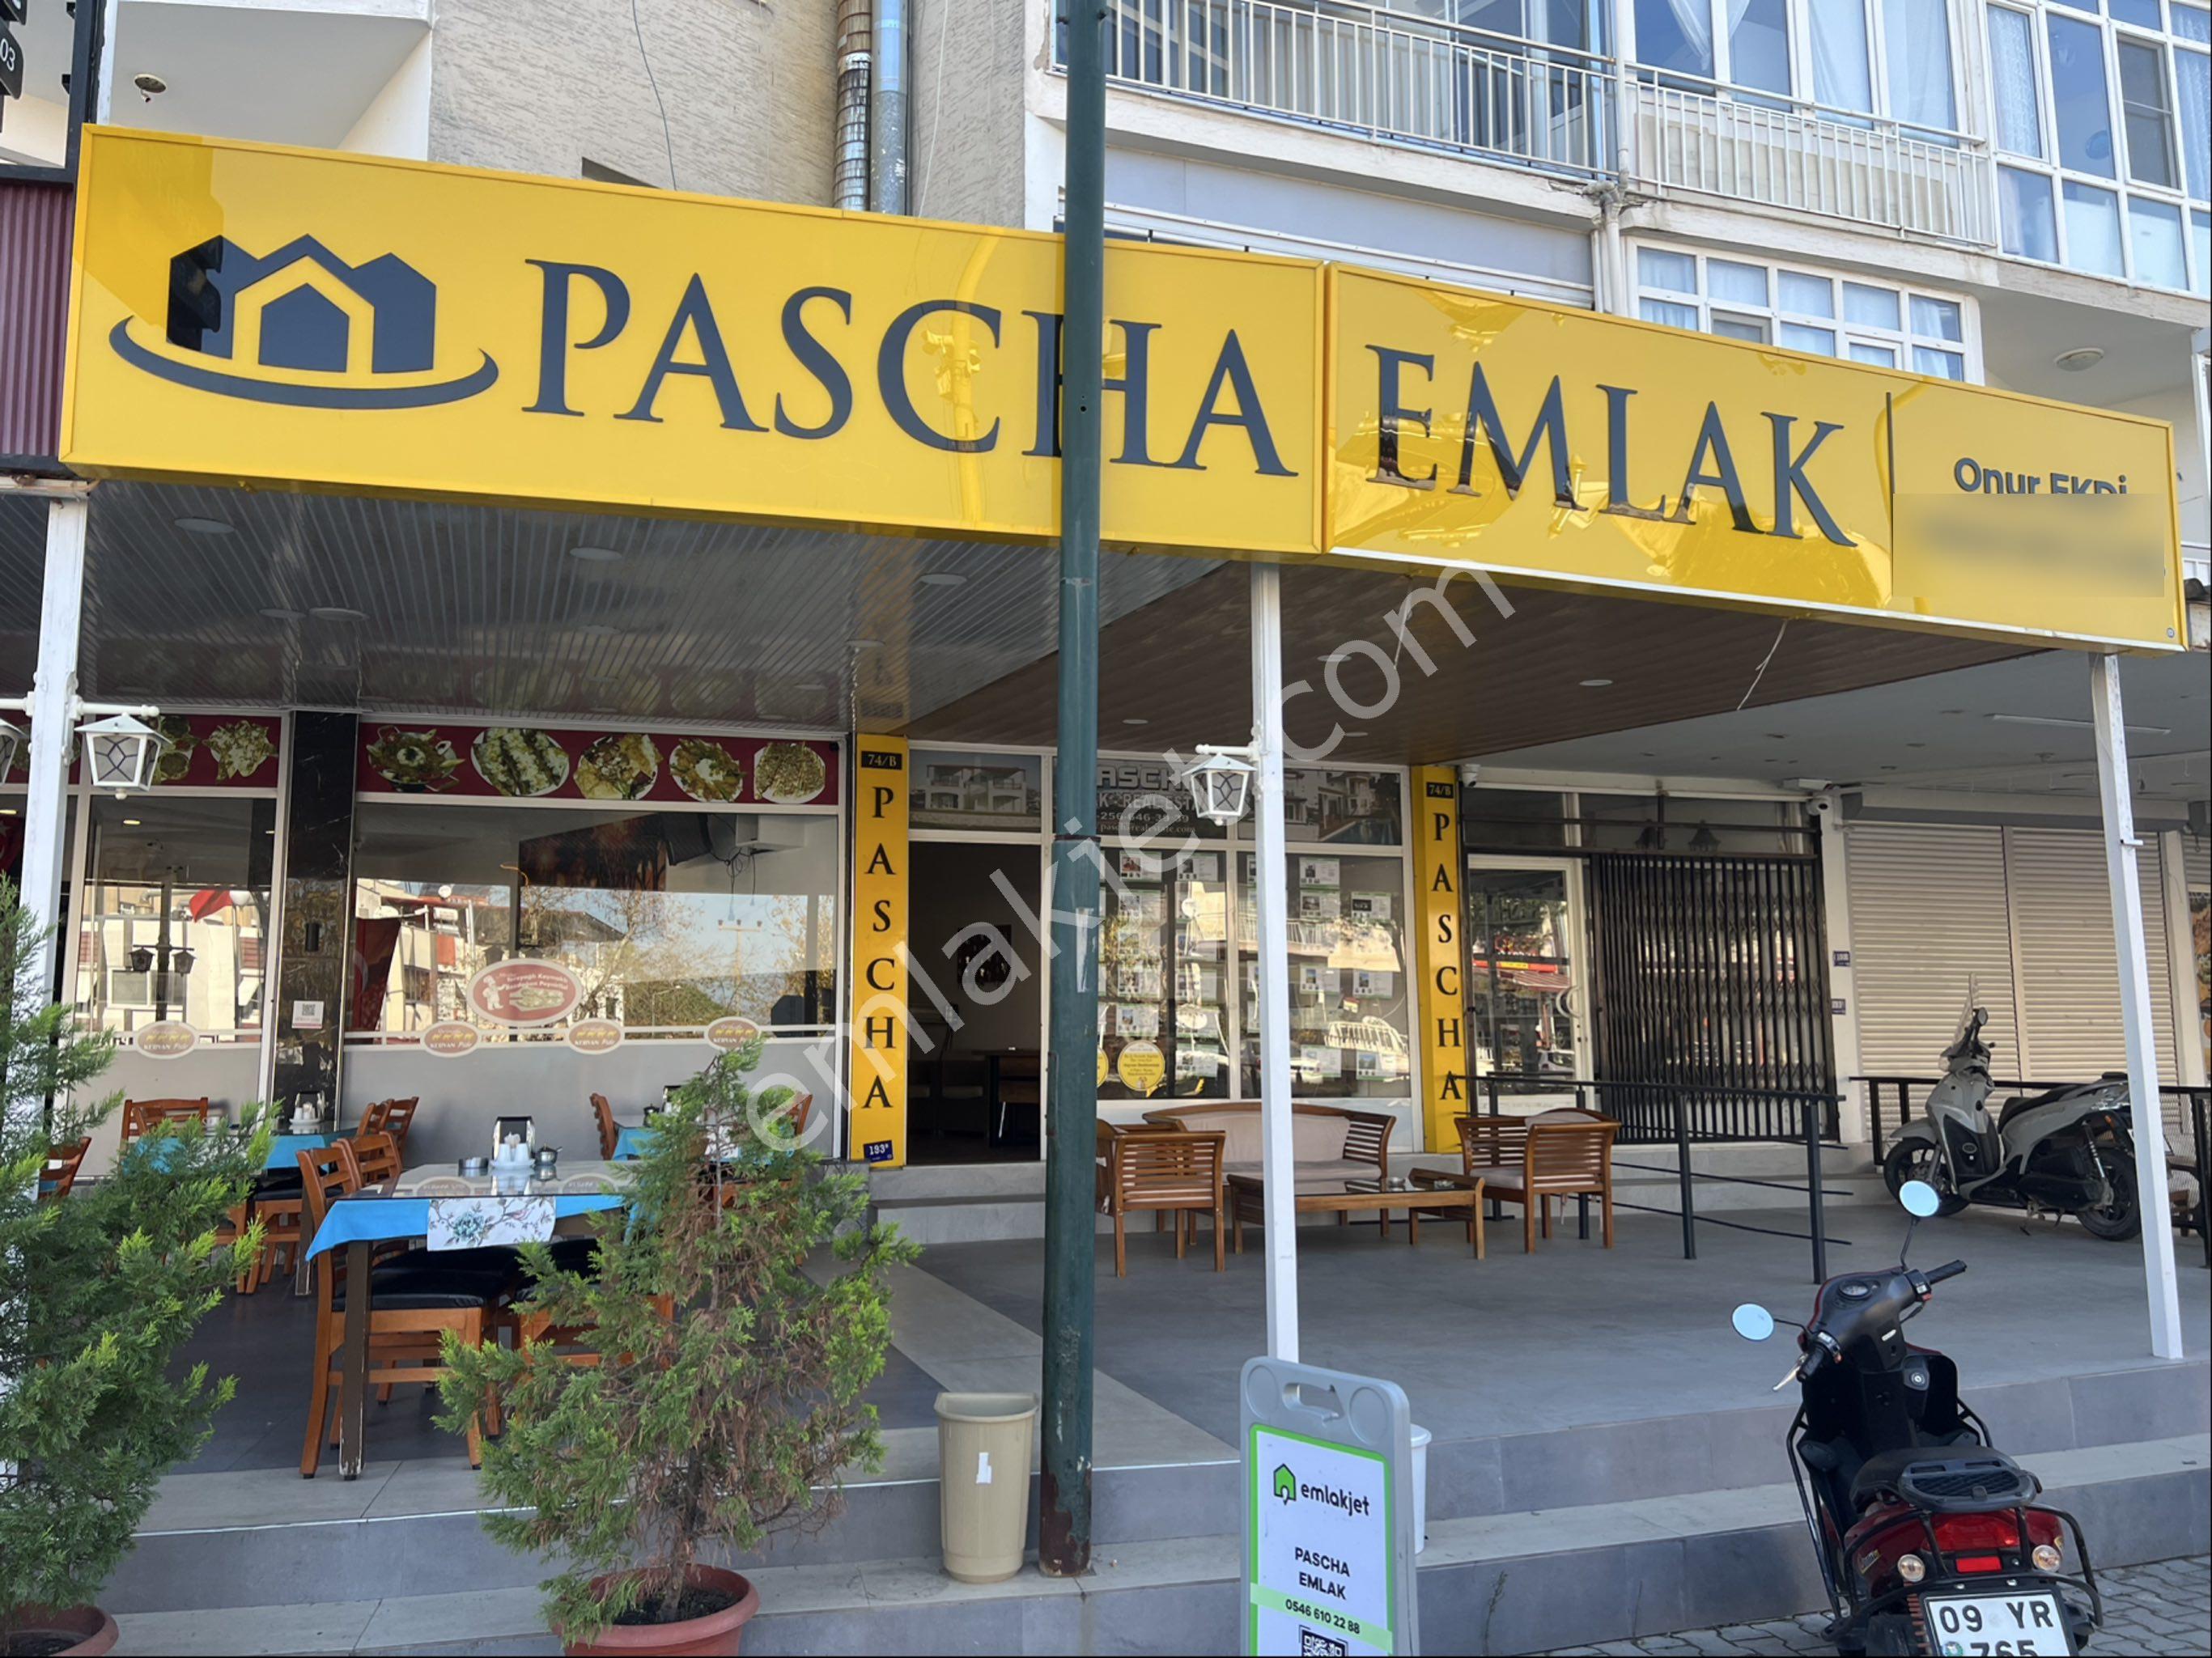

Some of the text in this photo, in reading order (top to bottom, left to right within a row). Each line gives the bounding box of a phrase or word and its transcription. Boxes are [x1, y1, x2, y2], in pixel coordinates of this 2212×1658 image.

[520, 257, 1857, 548] PASCHA EMLAK
[1954, 457, 2040, 494] Onur
[868, 753, 897, 767] 74/B
[1096, 765, 1190, 791] ASCH
[861, 786, 896, 1109] PASCHA
[1432, 812, 1462, 1100] PASCHA
[1301, 1483, 1369, 1516] emlakjet
[1295, 1546, 1350, 1577] PASCHA
[1299, 1571, 1346, 1600] EMLAK
[1285, 1599, 1361, 1635] 0546 610 22 88
[1939, 1601, 2054, 1634] 09 YR
